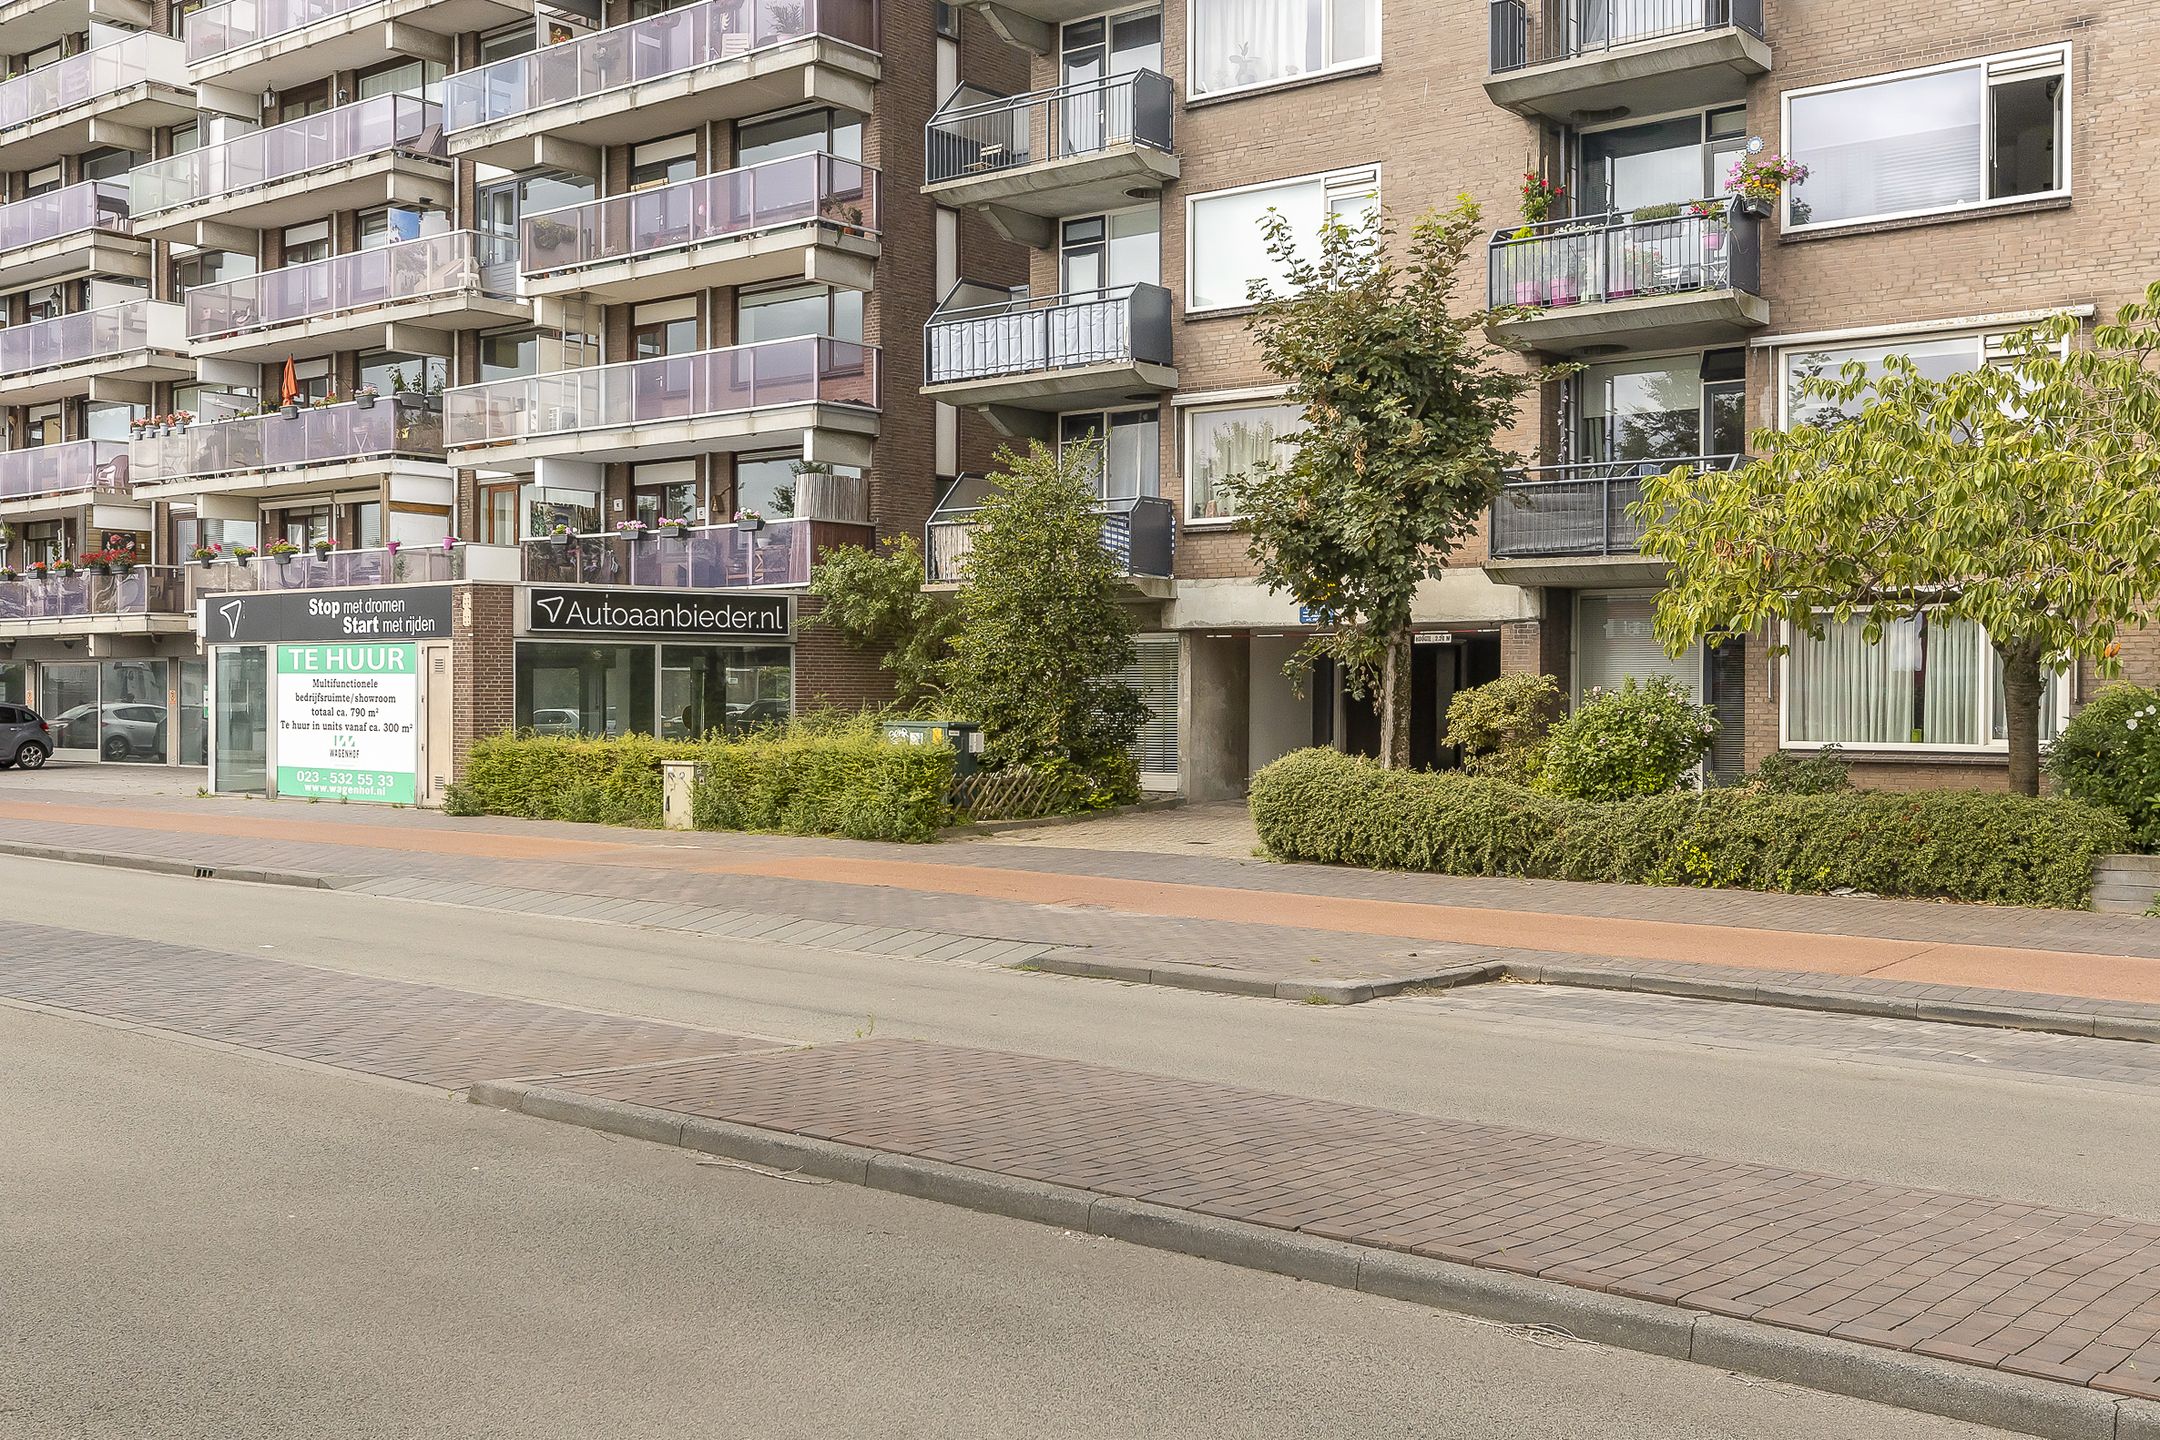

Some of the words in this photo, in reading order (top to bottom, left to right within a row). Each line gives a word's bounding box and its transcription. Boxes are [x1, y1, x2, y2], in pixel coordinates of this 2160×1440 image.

[309, 598, 341, 619] Stop
[343, 600, 364, 615] met
[364, 599, 405, 614] dromen
[565, 600, 783, 629] Autoaanbieder.nl
[343, 616, 379, 634] Start
[382, 618, 404, 633] met
[405, 615, 435, 636] rijden
[287, 648, 319, 671] TE
[326, 648, 405, 671] HUUR
[312, 678, 379, 688] Multifunctionele
[295, 692, 397, 705] bedrijfsruimte/showroom
[311, 707, 334, 717] totaal
[336, 709, 348, 717] ca.
[350, 707, 366, 717] 790
[280, 720, 290, 729] Te
[292, 720, 310, 730] huur
[312, 721, 321, 731] in
[322, 721, 343, 731] units
[344, 722, 368, 732] vanaf
[368, 724, 381, 732] ca.
[383, 722, 400, 733] 300
[329, 748, 360, 759] WAGENHOF
[296, 770, 320, 783] 023
[329, 772, 353, 785] 532
[357, 774, 373, 786] 55
[377, 775, 394, 787] 33
[304, 784, 386, 796] www.wagenhof.nl
